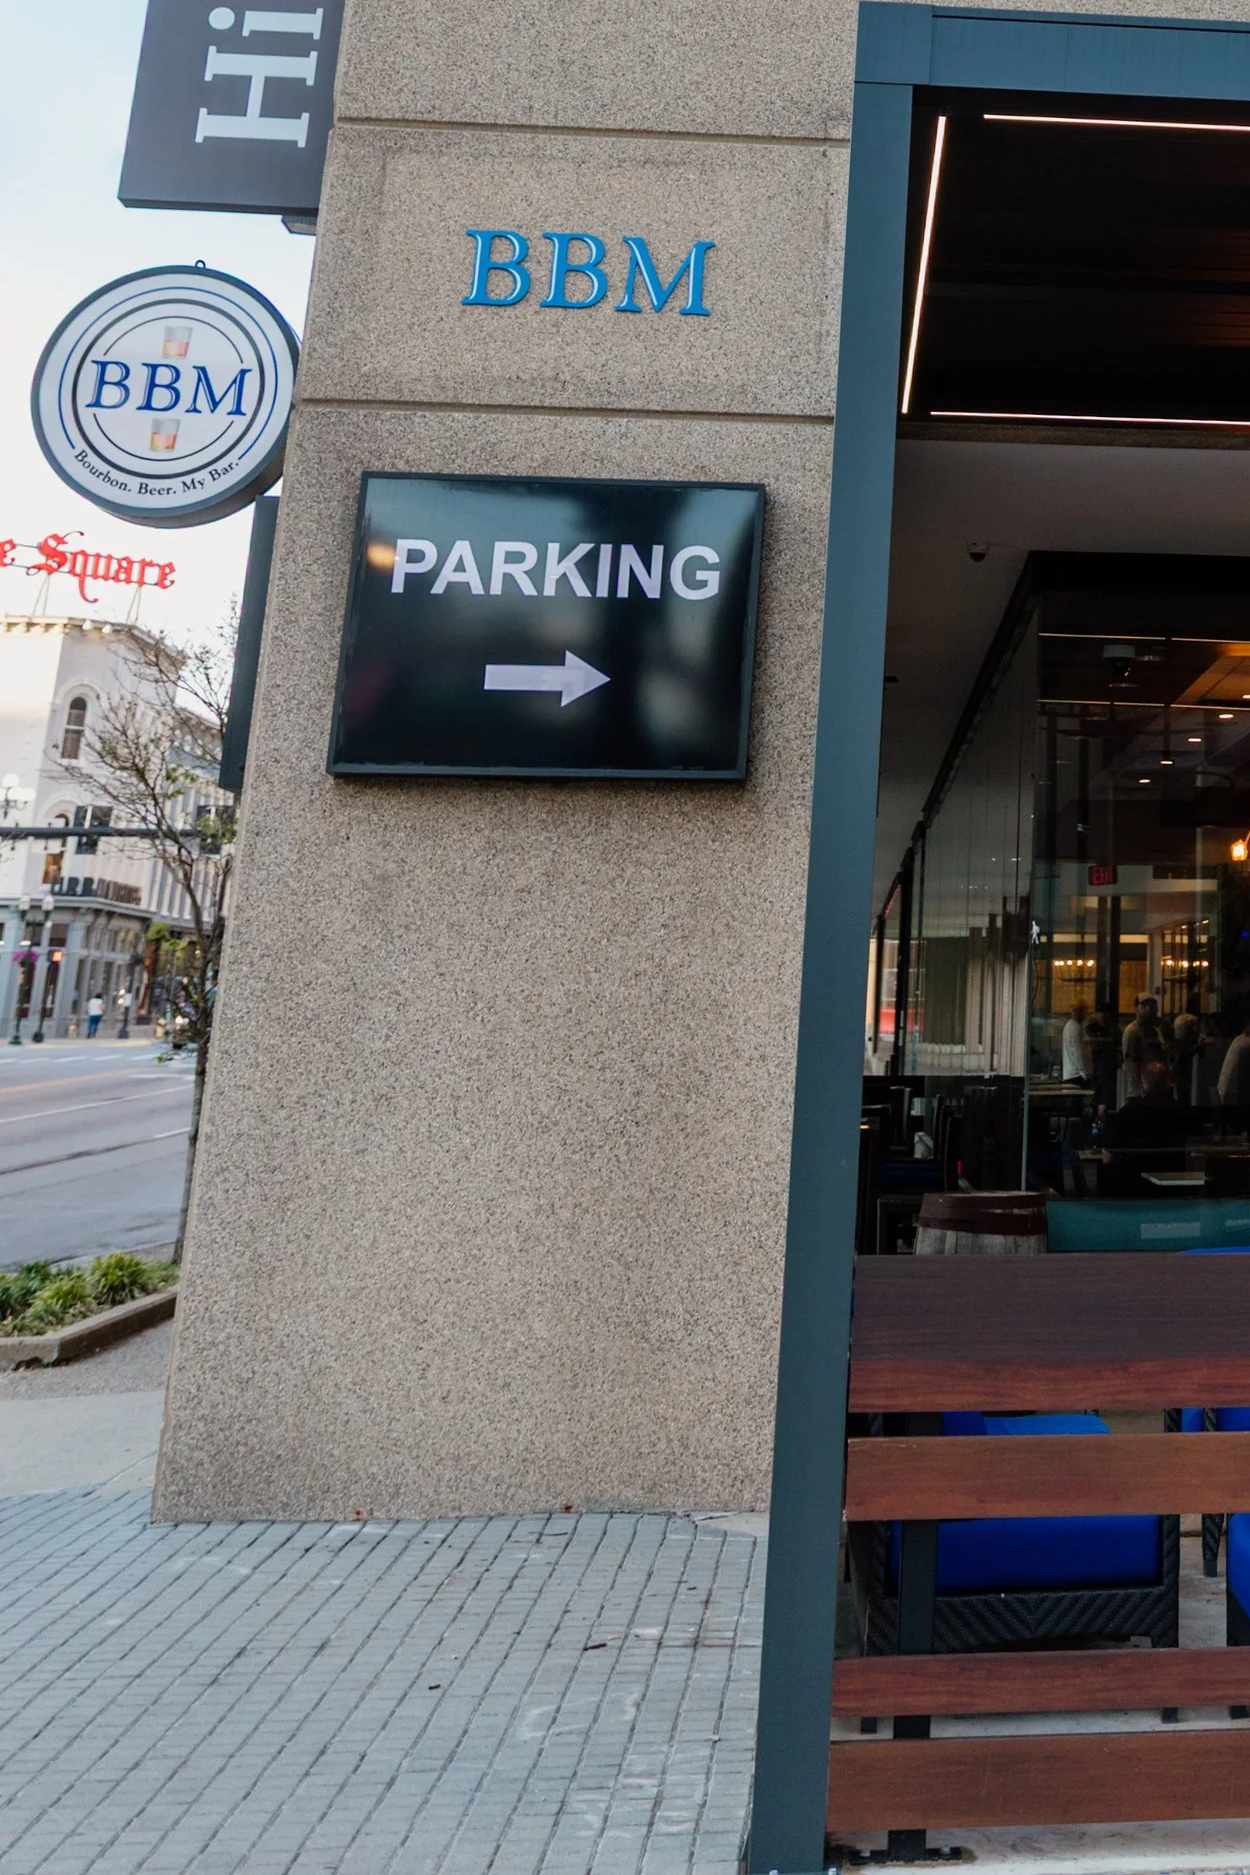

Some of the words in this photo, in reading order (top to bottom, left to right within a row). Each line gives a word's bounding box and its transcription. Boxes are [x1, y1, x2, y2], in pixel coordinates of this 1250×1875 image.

[460, 229, 716, 316] BBM
[85, 360, 252, 416] BBM
[74, 449, 132, 493] Bourbon.
[137, 482, 177, 496] Beer.
[181, 478, 206, 495] My
[208, 462, 239, 482] Bar.
[28, 532, 176, 603] Square
[391, 538, 721, 601] PARKING
